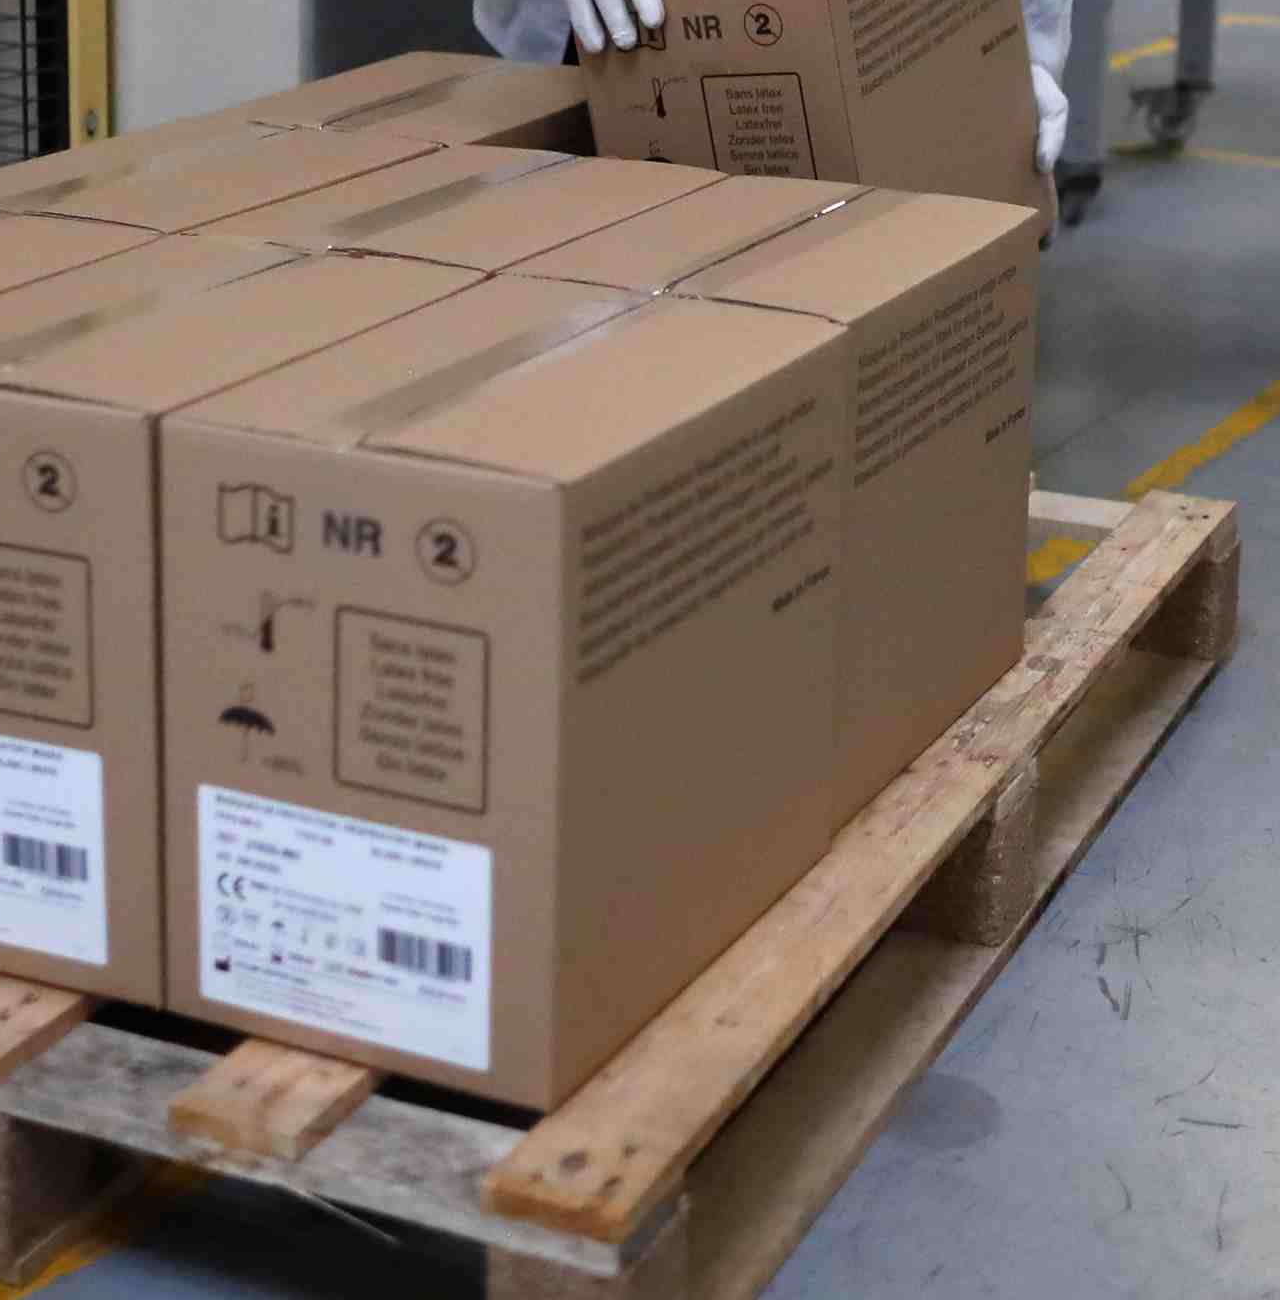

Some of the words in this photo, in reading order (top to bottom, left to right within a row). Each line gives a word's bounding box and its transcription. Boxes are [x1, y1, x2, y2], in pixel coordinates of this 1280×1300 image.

[682, 15, 723, 41] NR
[36, 464, 60, 497] 2
[323, 511, 382, 557] NR
[432, 533, 459, 568] 2
